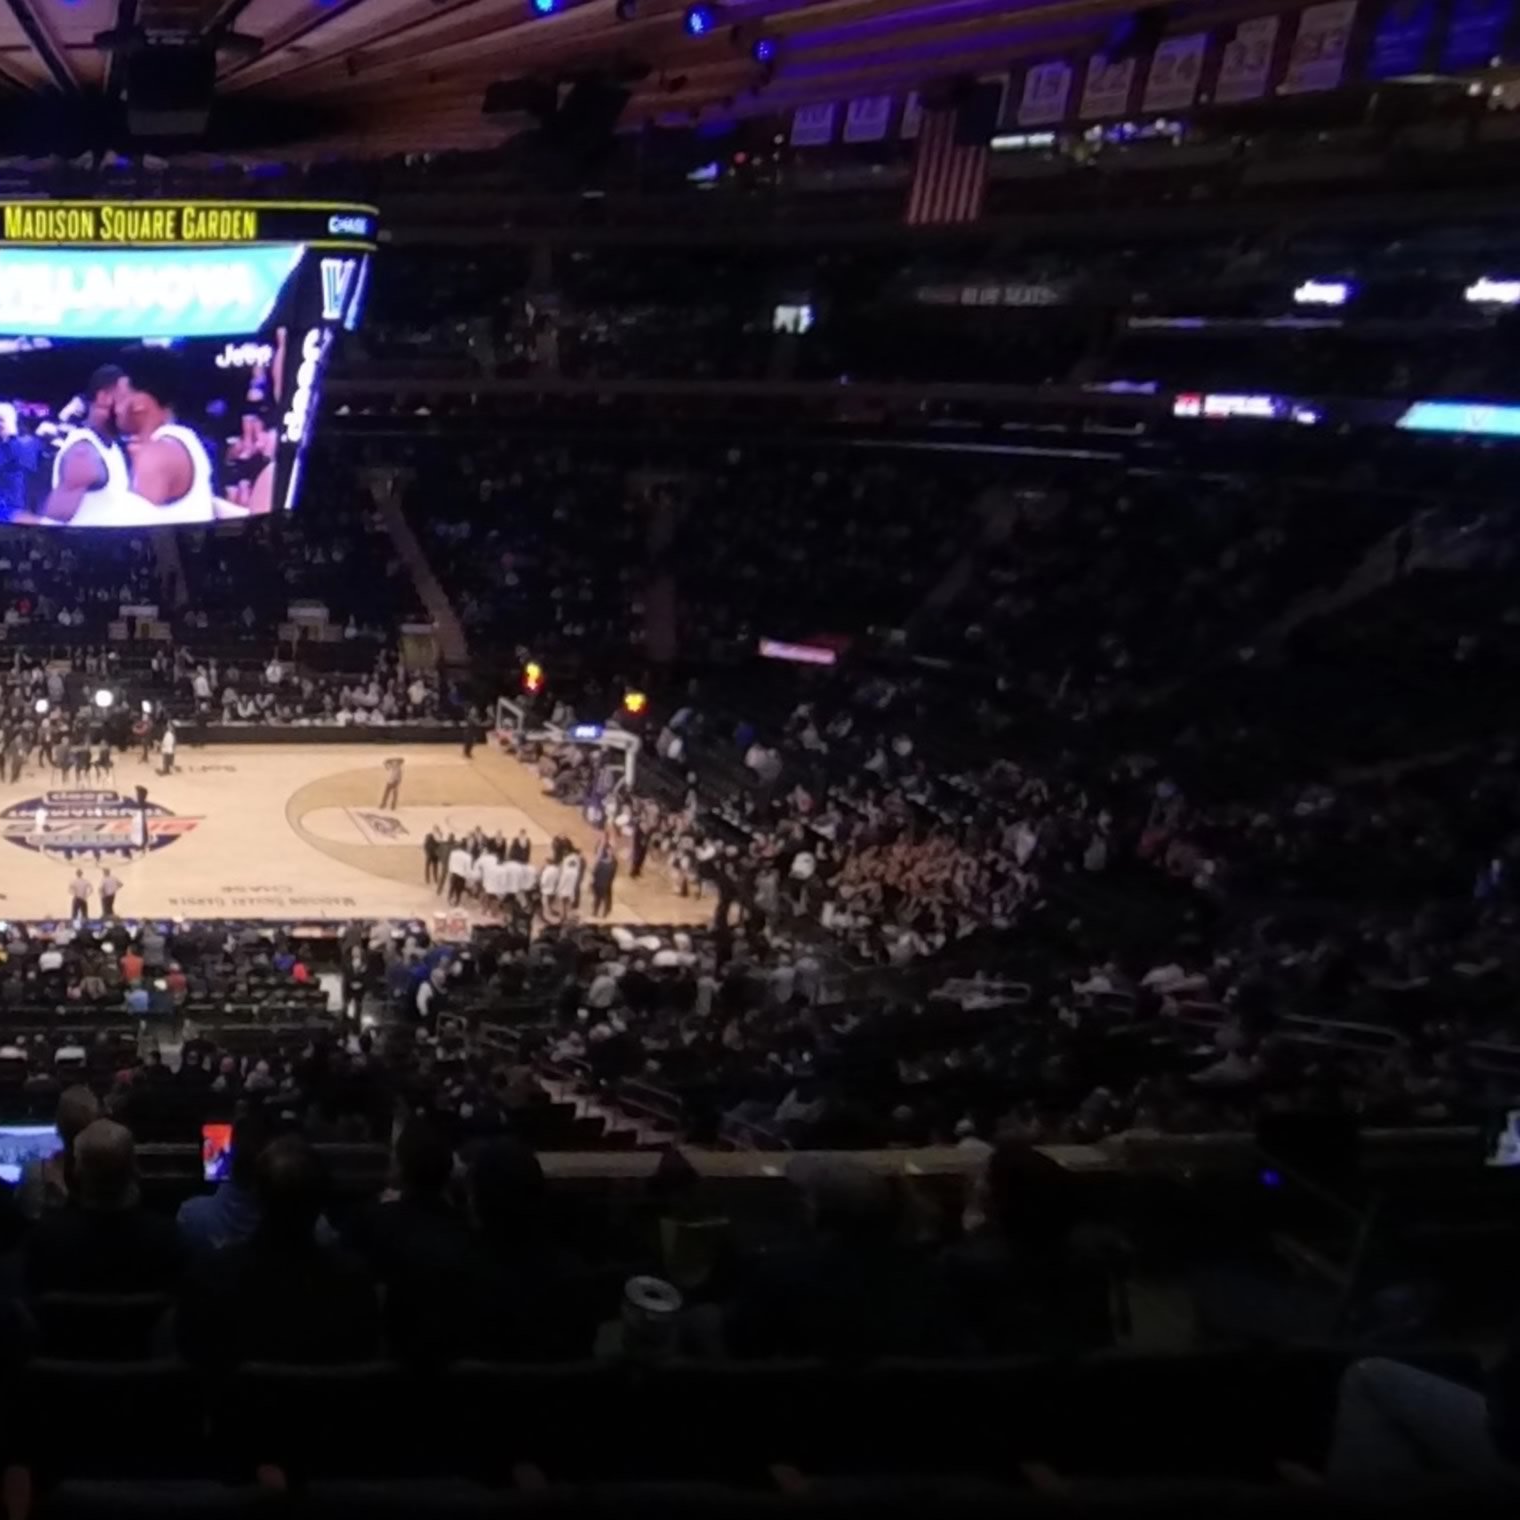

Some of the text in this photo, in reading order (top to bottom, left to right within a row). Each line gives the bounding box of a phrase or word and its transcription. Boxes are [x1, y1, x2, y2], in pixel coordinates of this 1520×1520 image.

[4, 206, 256, 241] MADISON SQUARE GARDEN
